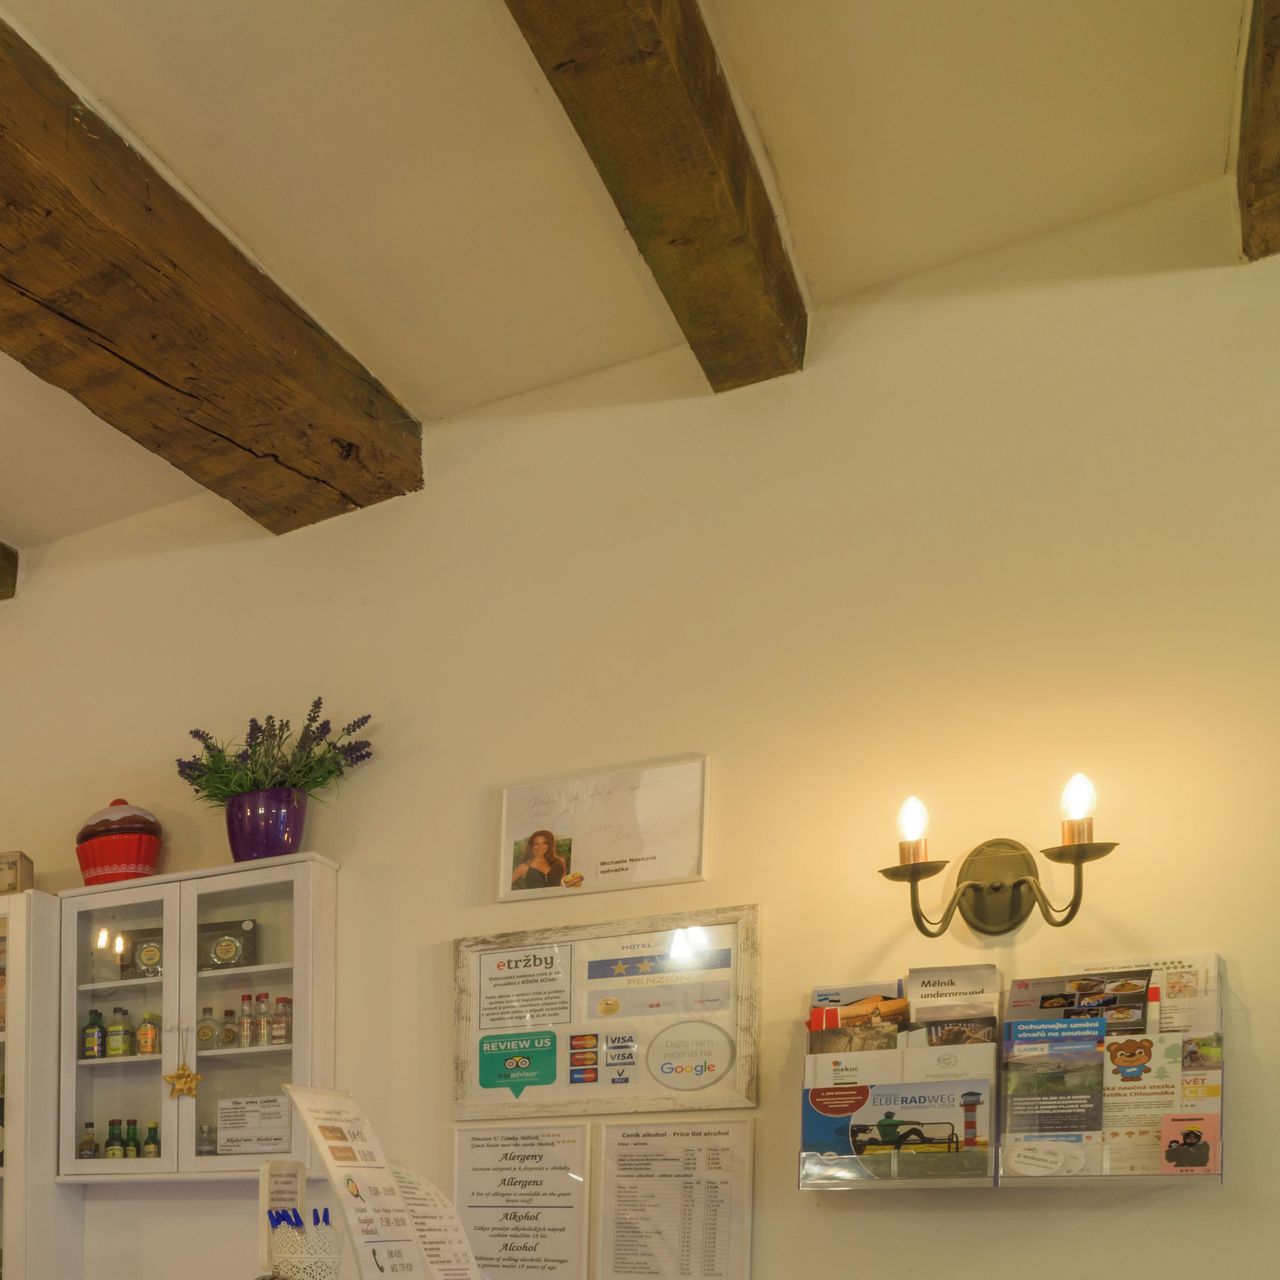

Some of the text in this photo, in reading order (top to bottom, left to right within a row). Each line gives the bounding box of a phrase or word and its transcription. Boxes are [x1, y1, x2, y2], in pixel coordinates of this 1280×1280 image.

[600, 858, 628, 866] Michaela
[496, 954, 554, 971] etržby
[921, 979, 956, 988] Mělník
[483, 1038, 551, 1051] REVIEW US
[610, 1036, 634, 1044] VISA
[610, 1053, 634, 1061] VISA
[661, 1060, 716, 1076] Google
[872, 1094, 956, 1107] ELBERADWEG
[498, 1152, 544, 1163] Alergeny
[497, 1178, 544, 1189] Allergens
[499, 1212, 541, 1222] Alkohol
[498, 1242, 538, 1252] Alcohol
